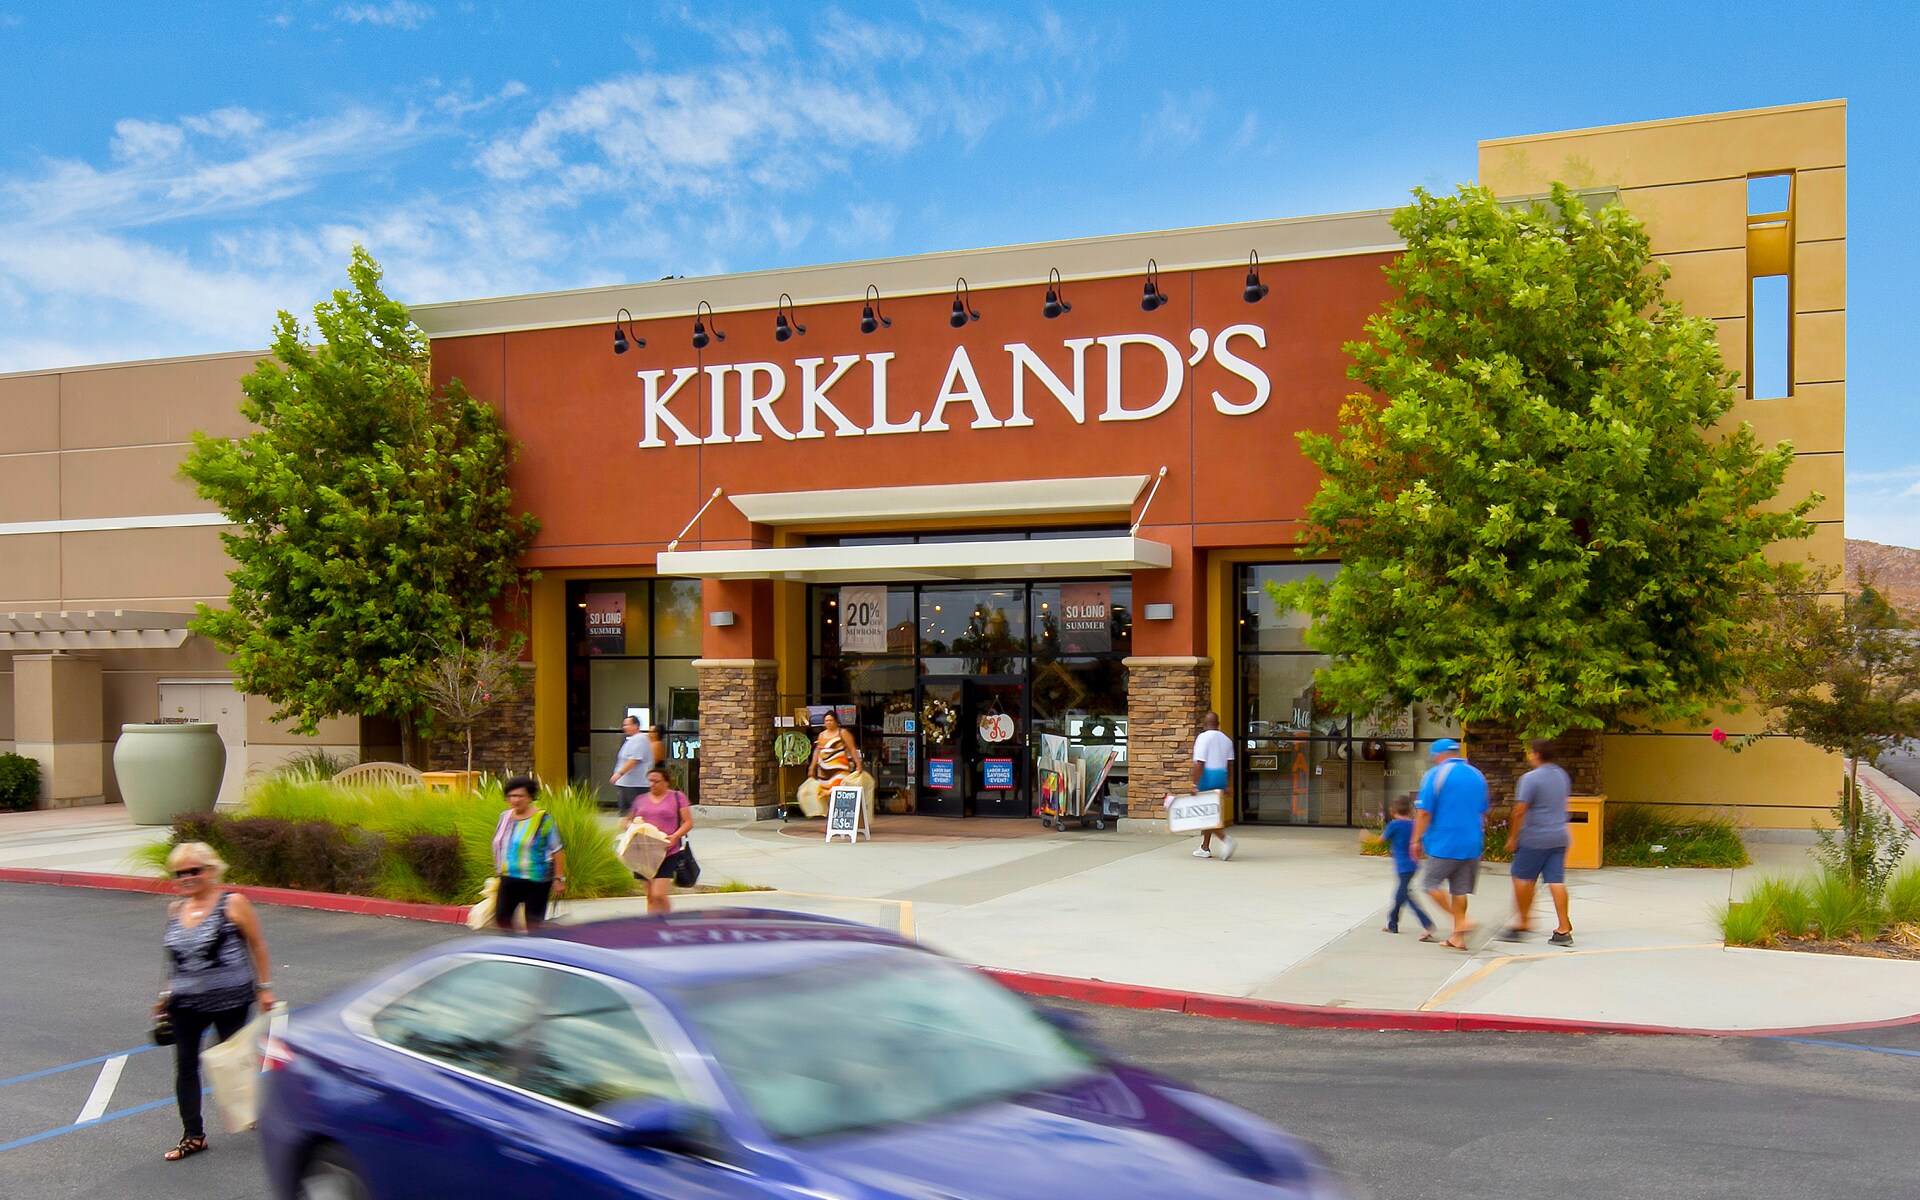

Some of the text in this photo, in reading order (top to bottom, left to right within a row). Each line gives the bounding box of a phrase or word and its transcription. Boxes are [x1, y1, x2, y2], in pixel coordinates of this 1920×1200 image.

[637, 324, 1271, 449] KIRKLAND'S
[847, 602, 880, 626] 20%
[1066, 605, 1105, 618] SO LONG
[590, 613, 621, 624] SO LONG
[590, 627, 621, 635] SUMMER
[1066, 621, 1105, 630] SUMMER
